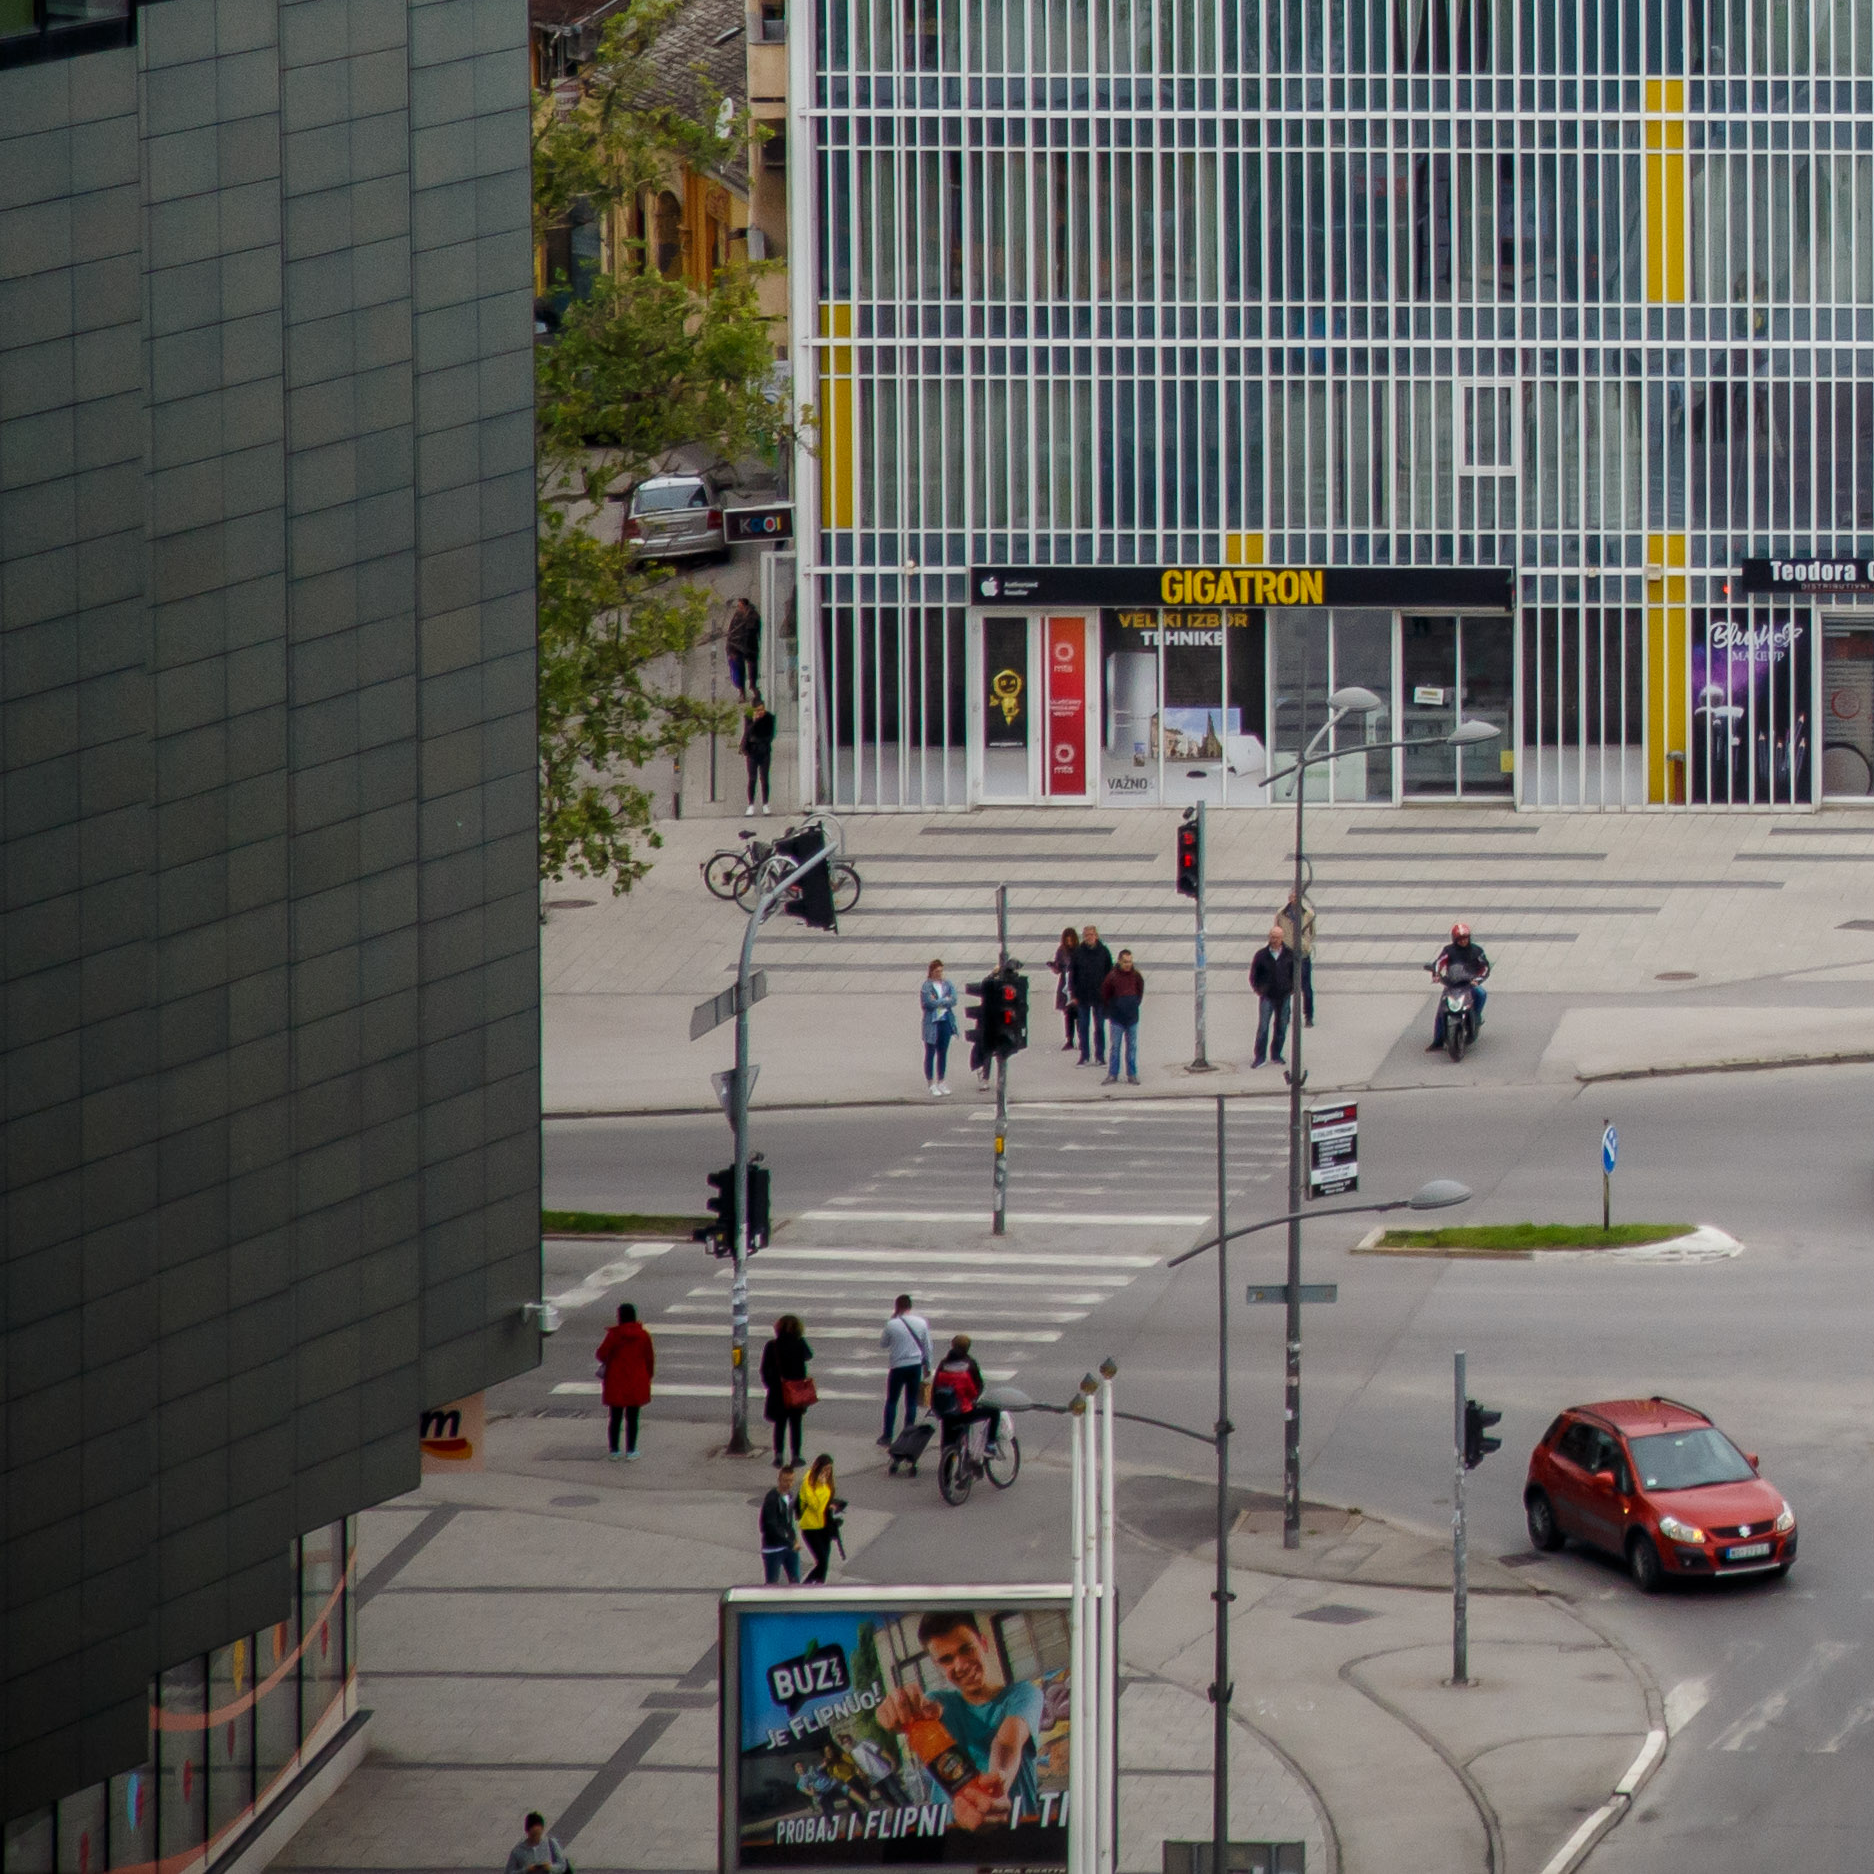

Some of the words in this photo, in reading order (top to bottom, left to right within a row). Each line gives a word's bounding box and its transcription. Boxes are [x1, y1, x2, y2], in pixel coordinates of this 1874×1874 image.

[1771, 561, 1857, 582] Teodora
[1160, 569, 1325, 606] GIGATRON
[1118, 613, 1181, 628] VELKI
[1106, 775, 1147, 790] VAŽNO
[788, 1679, 883, 1743] FLIPNUO!
[775, 1815, 839, 1845] PROBAJ
[847, 1813, 857, 1842] I
[863, 1804, 949, 1840] FLIPNI
